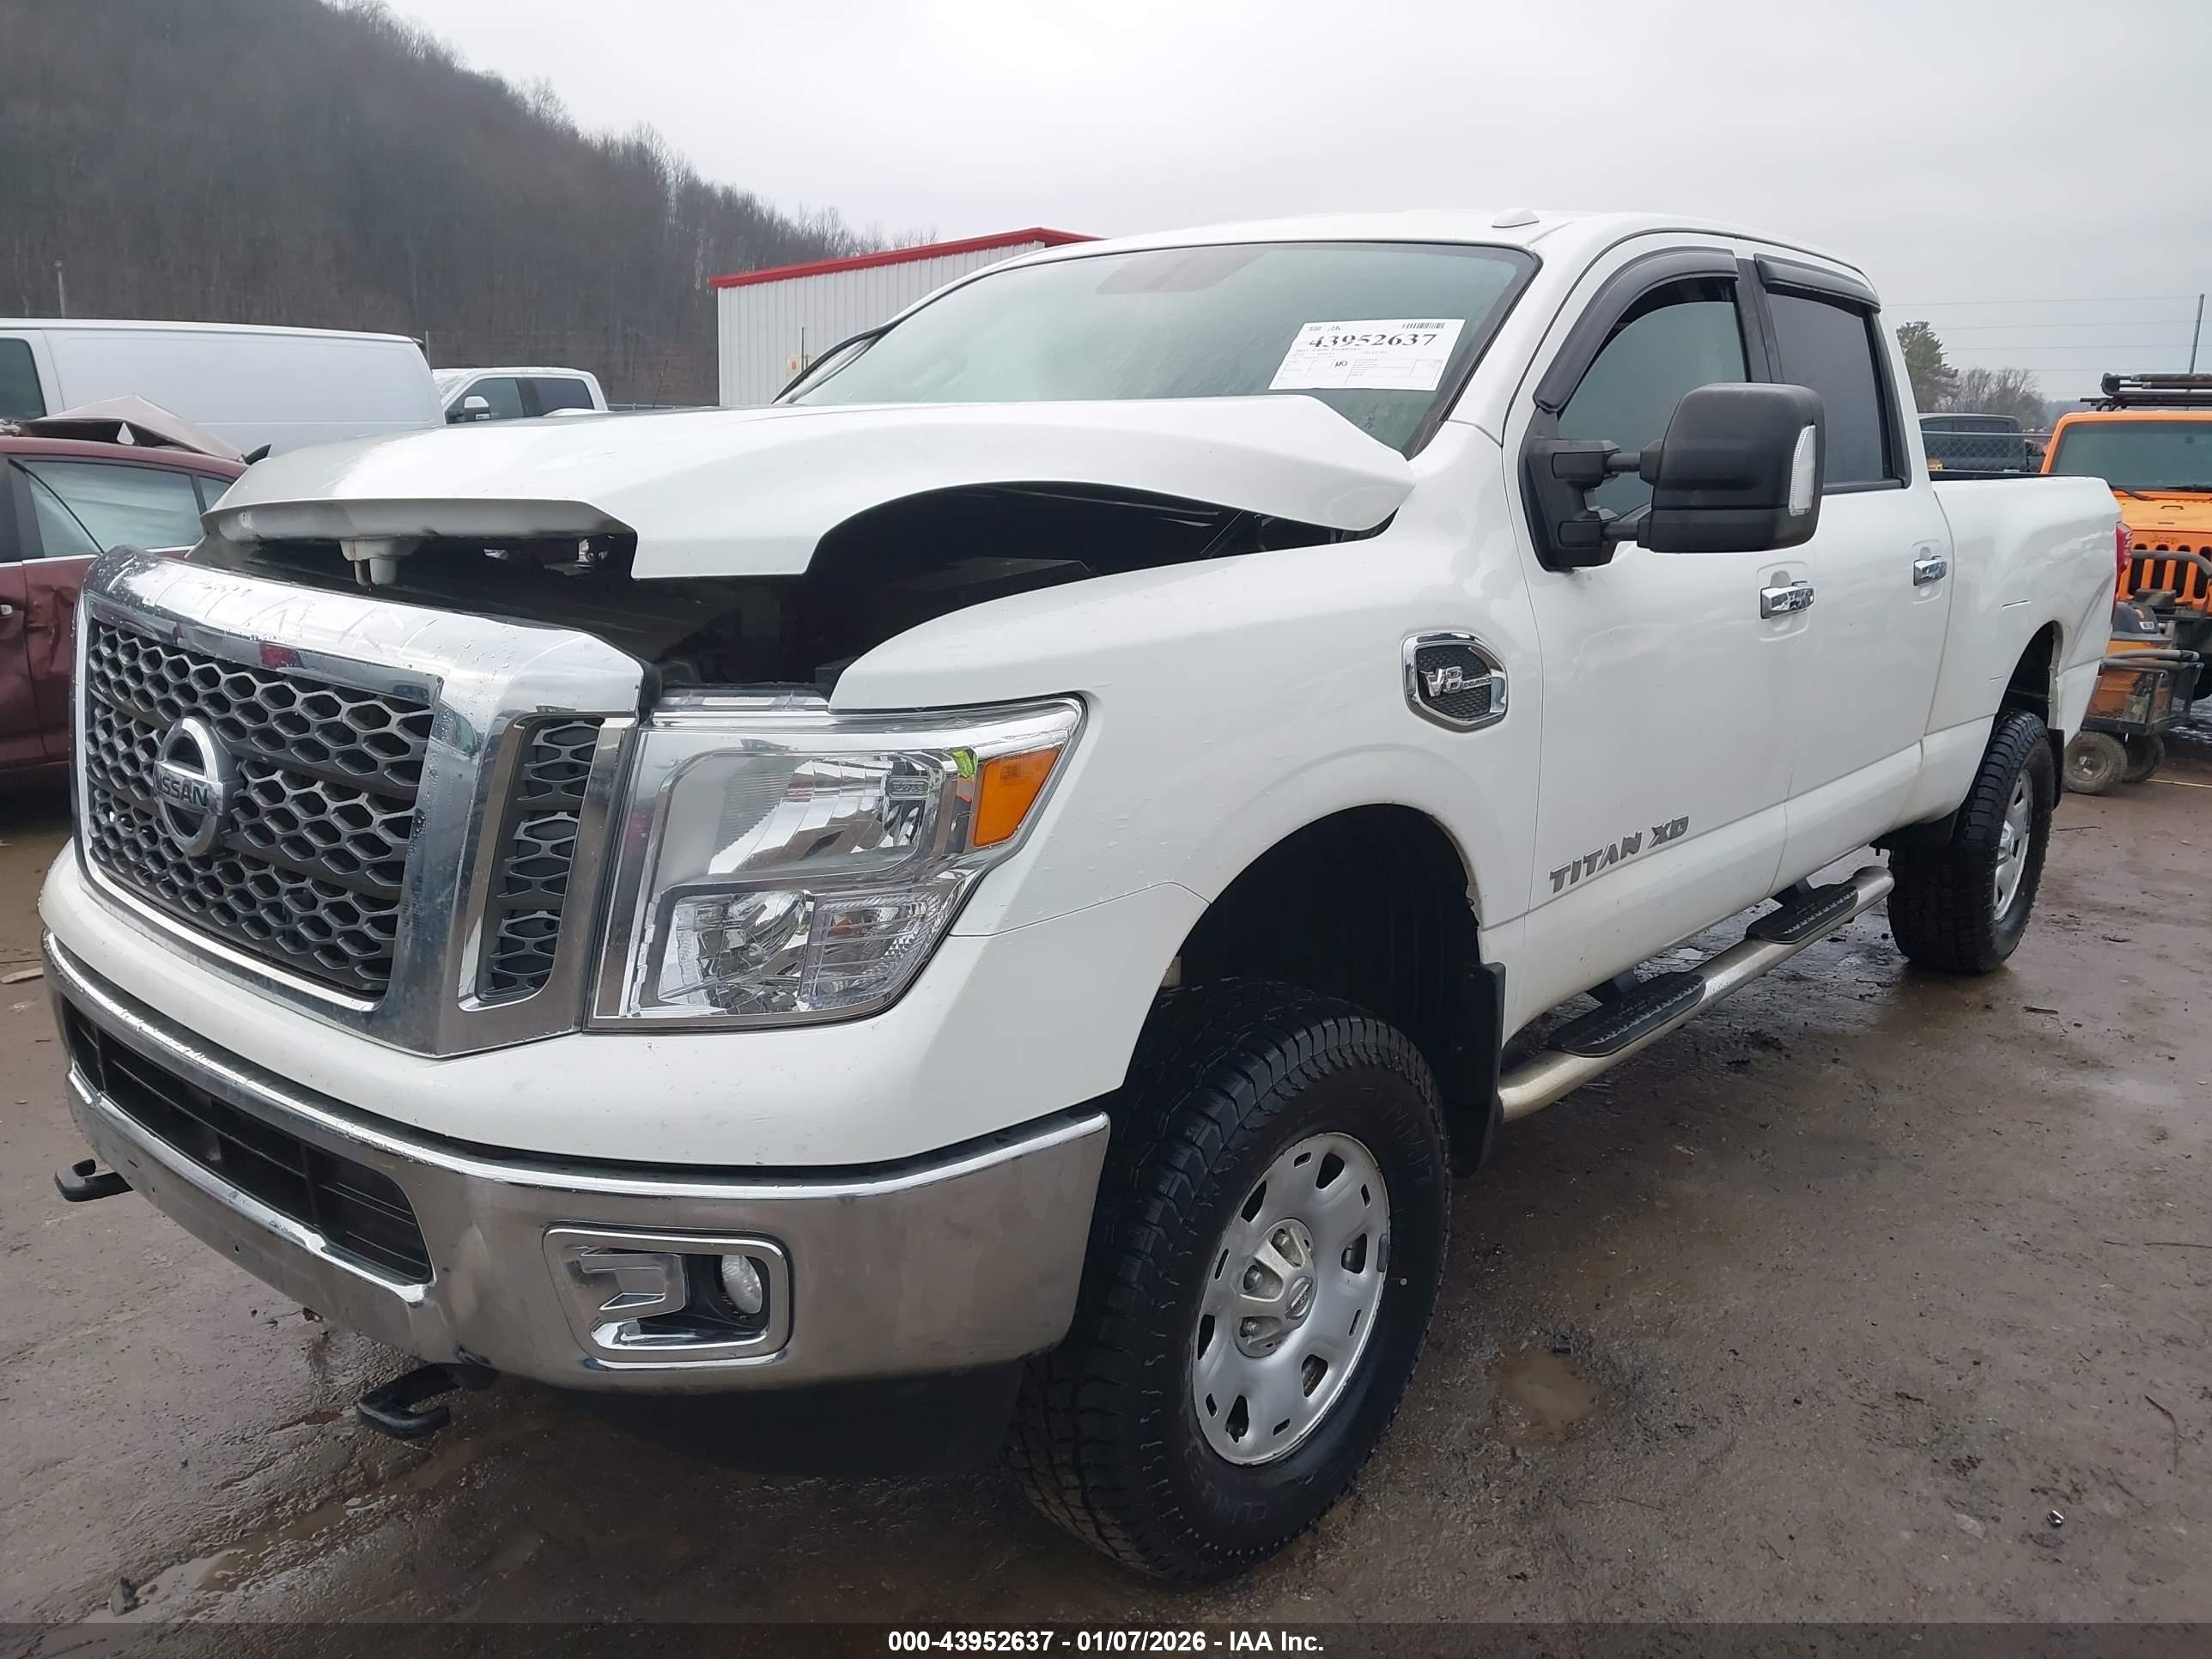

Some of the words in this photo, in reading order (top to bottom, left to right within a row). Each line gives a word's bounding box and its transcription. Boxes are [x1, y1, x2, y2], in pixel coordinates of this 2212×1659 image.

[1308, 332, 1438, 348] 43952637
[1419, 665, 1463, 697] V8
[1549, 831, 1642, 894] TITAN
[1647, 815, 1689, 849] XD
